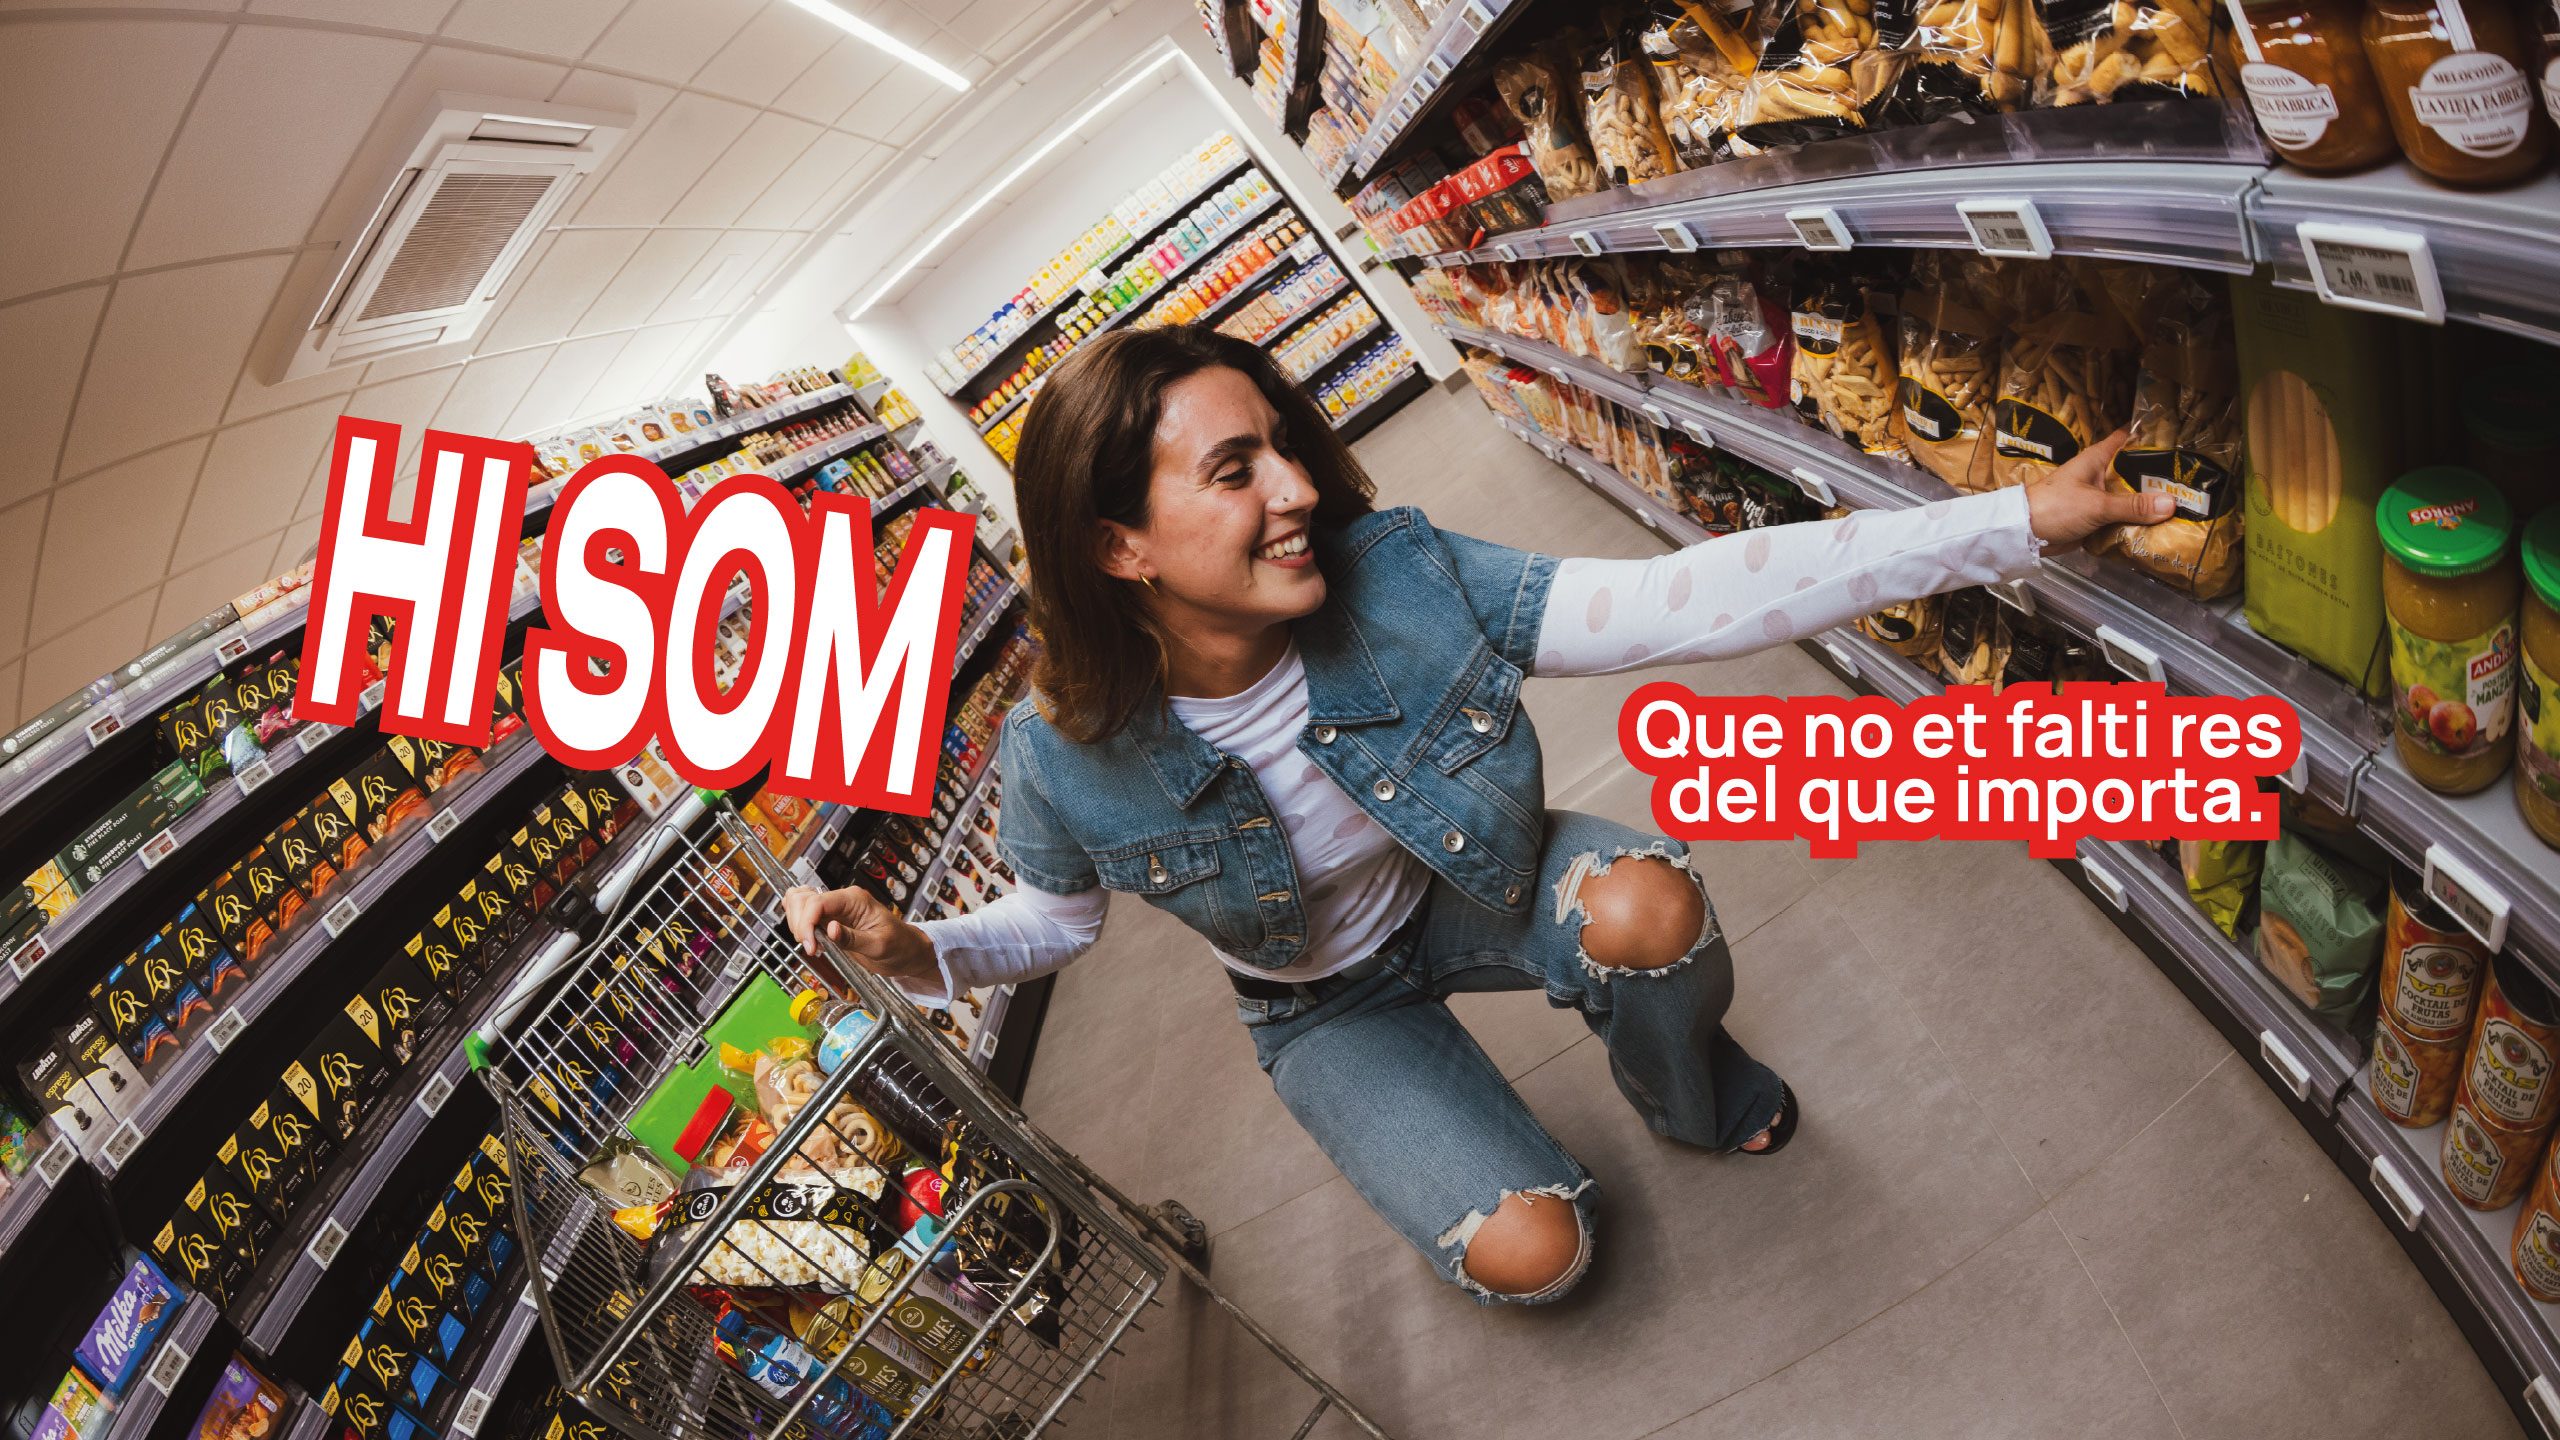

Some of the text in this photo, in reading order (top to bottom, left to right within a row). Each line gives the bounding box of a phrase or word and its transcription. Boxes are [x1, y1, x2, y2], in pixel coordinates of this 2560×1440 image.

[2410, 500, 2475, 523] ANDROS
[237, 684, 270, 711] L'OR
[205, 698, 240, 737] L'OR
[362, 775, 397, 812] L'OR
[588, 788, 619, 818] L'OR
[84, 818, 113, 843] STARBUCKS
[314, 812, 348, 847] L'OR
[553, 818, 582, 846] L'OR
[98, 838, 127, 865] STARBUCKS
[282, 838, 317, 872] L'OR
[530, 837, 560, 868] L'OR
[249, 867, 285, 903] L'OR
[504, 863, 535, 894] L'OR
[215, 894, 252, 934] L'OR
[478, 891, 510, 924] L'OR
[179, 928, 217, 968] L'OR
[453, 916, 485, 950] L'OR
[144, 959, 183, 1000] L'OR
[425, 945, 459, 981] L'OR
[109, 990, 149, 1035] L'OR
[381, 987, 421, 1030] L'OR
[2401, 985, 2451, 1010] COCKTAIL
[2411, 1003, 2451, 1019] FRUTAS
[68, 1017, 94, 1044] LAVAZZA
[32, 1051, 58, 1081] LAVAZZA
[81, 1035, 107, 1064] espresso
[45, 1070, 71, 1101] espresso
[320, 1052, 364, 1101] L'OR
[2479, 1056, 2537, 1103] COCKTAIL DE
[2482, 1079, 2518, 1110] FRUTAS
[272, 1113, 312, 1158] L'OR
[241, 1147, 282, 1193] L'OR
[210, 1192, 251, 1240] L'OR
[450, 1212, 488, 1257] L'OR
[178, 1233, 220, 1284] L'OR
[424, 1253, 463, 1300] L'OR
[95, 1289, 138, 1366] Milka
[127, 1321, 144, 1350] OREO
[396, 1296, 436, 1343] L'OR
[367, 1344, 407, 1391] L'OR
